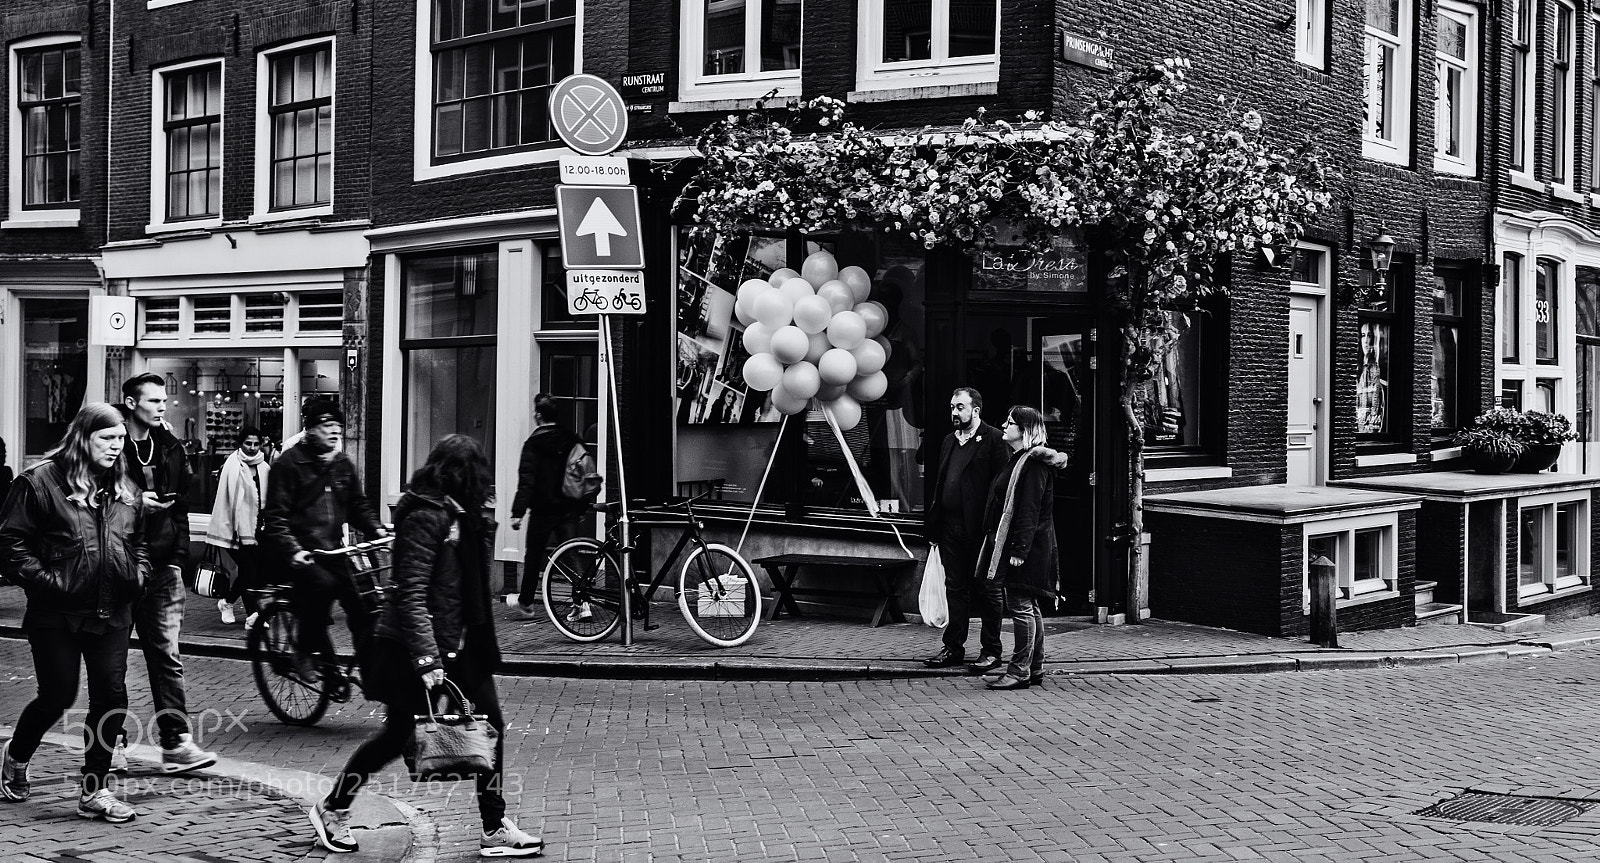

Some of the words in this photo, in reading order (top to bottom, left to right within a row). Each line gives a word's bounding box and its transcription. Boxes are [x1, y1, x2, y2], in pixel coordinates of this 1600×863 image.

[622, 73, 665, 86] RUNSTRAAT
[641, 85, 665, 93] CENTRUM
[564, 165, 626, 175] 12.00-18.00h
[573, 273, 640, 285] uitgezonderd
[1029, 272, 1040, 280] by
[1043, 272, 1075, 280] Simone
[1535, 300, 1549, 323] 33
